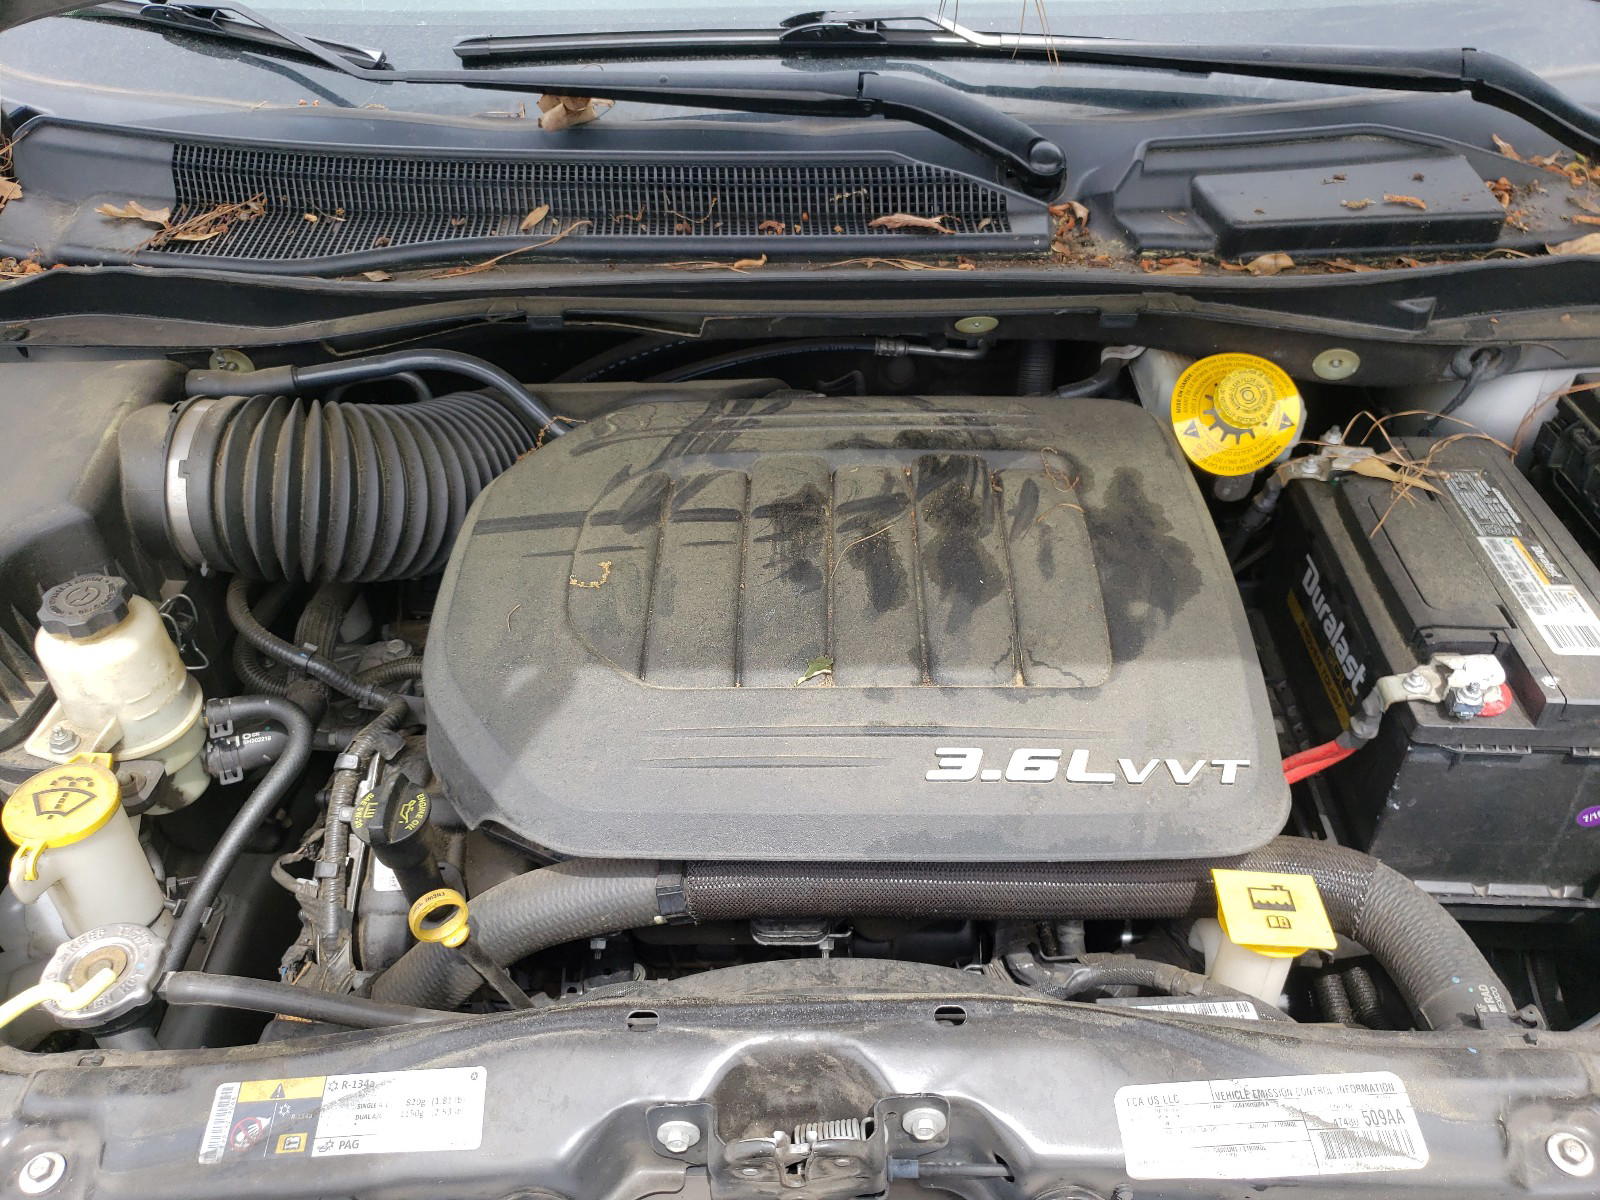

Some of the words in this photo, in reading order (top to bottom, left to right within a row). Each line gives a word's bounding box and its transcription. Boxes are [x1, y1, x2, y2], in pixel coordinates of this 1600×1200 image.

[1302, 554, 1366, 697] Duralast
[925, 747, 1116, 784] 3.6L
[1116, 758, 1251, 786] VVT
[416, 792, 427, 819] ENGINE
[1147, 1095, 1161, 1105] US
[1163, 1094, 1180, 1105] LLC
[1213, 1089, 1249, 1101] VEHICLE
[1251, 1087, 1293, 1099] EMISSION
[1336, 1082, 1395, 1095] INFORMATION
[1361, 1108, 1406, 1127] 509AA
[338, 1139, 360, 1150] PAG
